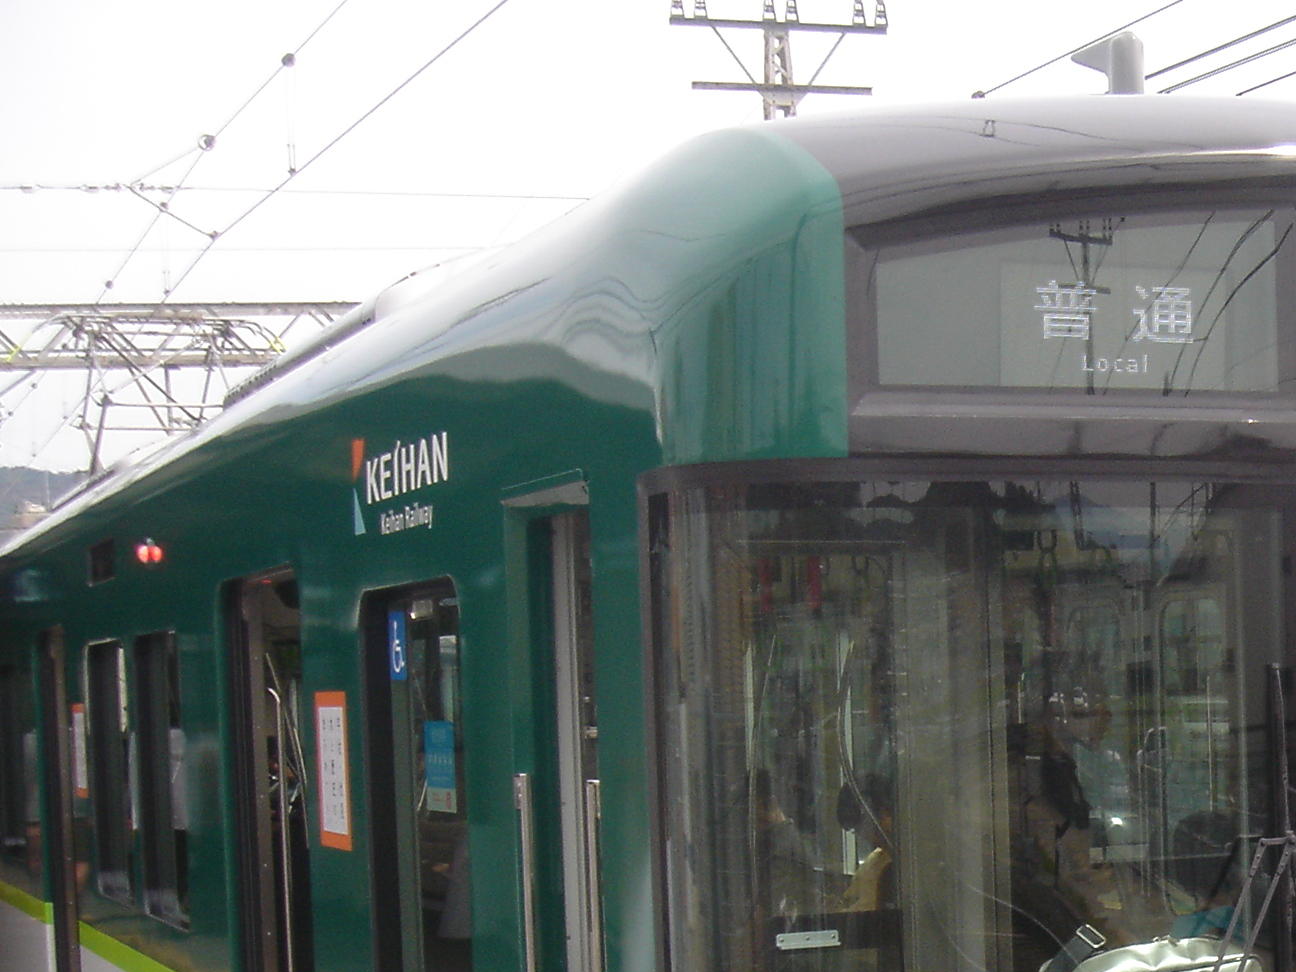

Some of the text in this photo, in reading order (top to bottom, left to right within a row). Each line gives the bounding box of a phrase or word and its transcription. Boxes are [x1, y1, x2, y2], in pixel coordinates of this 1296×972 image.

[1034, 280, 1195, 343] 普通
[1082, 353, 1149, 373] Local
[366, 431, 448, 505] KEIHAN
